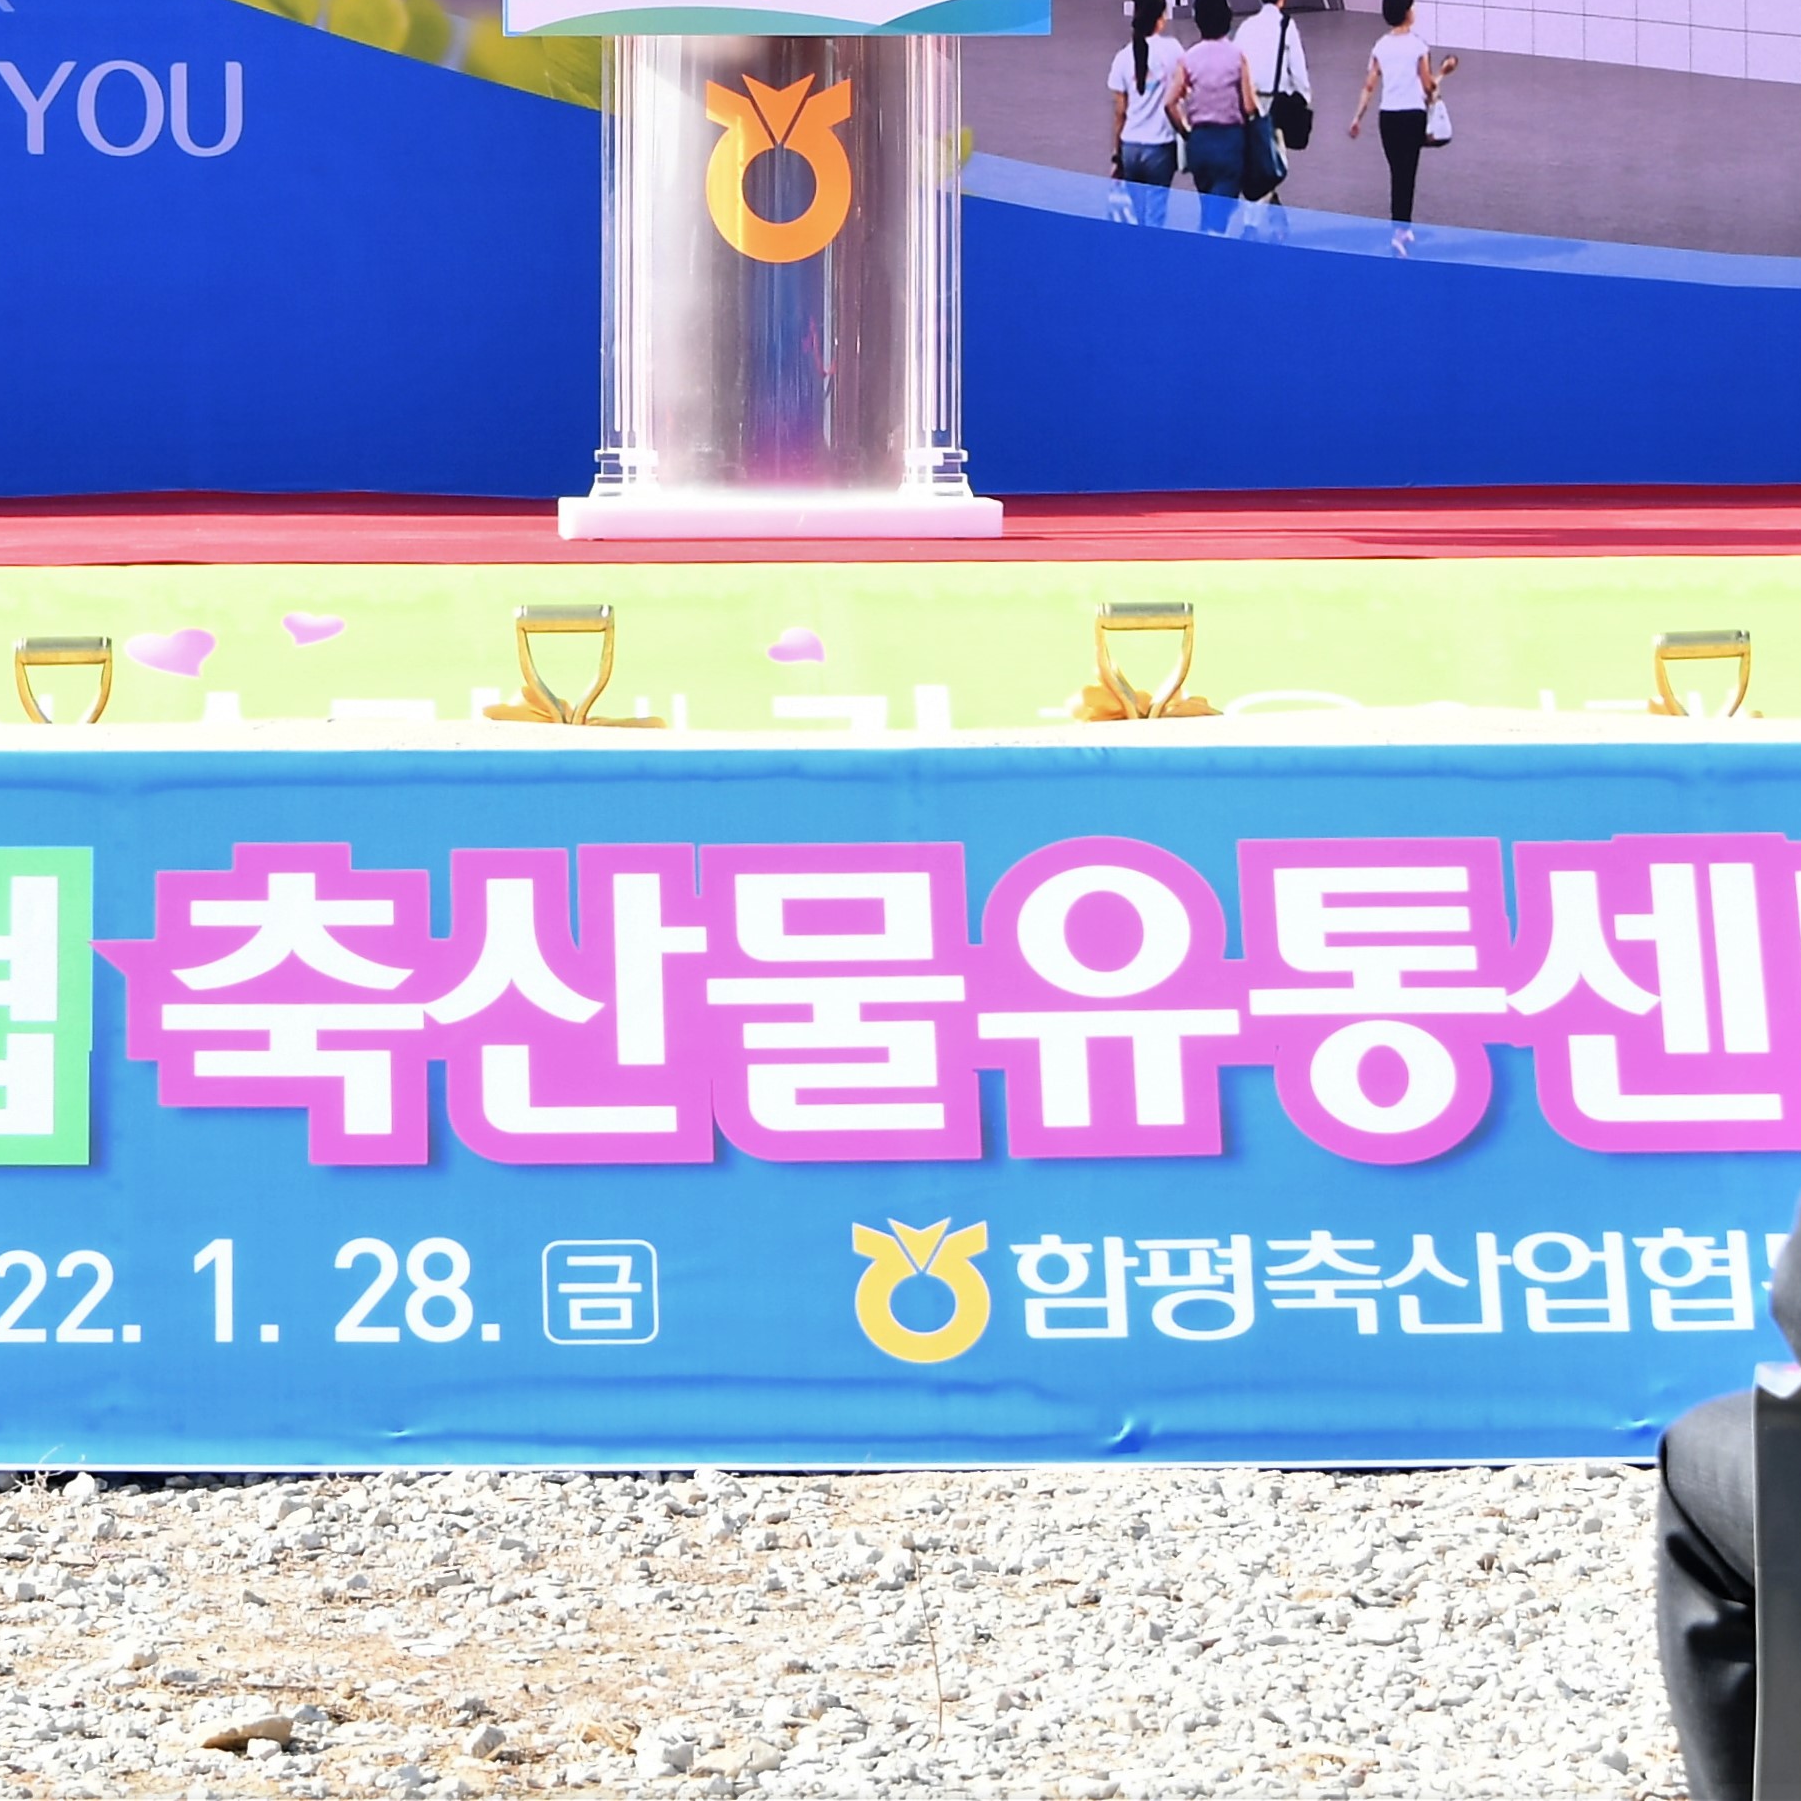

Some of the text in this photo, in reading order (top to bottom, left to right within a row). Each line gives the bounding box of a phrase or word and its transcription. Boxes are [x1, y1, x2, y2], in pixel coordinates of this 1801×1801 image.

[191, 1238, 281, 1345] 1.
[332, 1236, 502, 1345] 28.
[549, 1246, 652, 1340] 금
[1009, 1226, 1774, 1344] 함평축산업협
